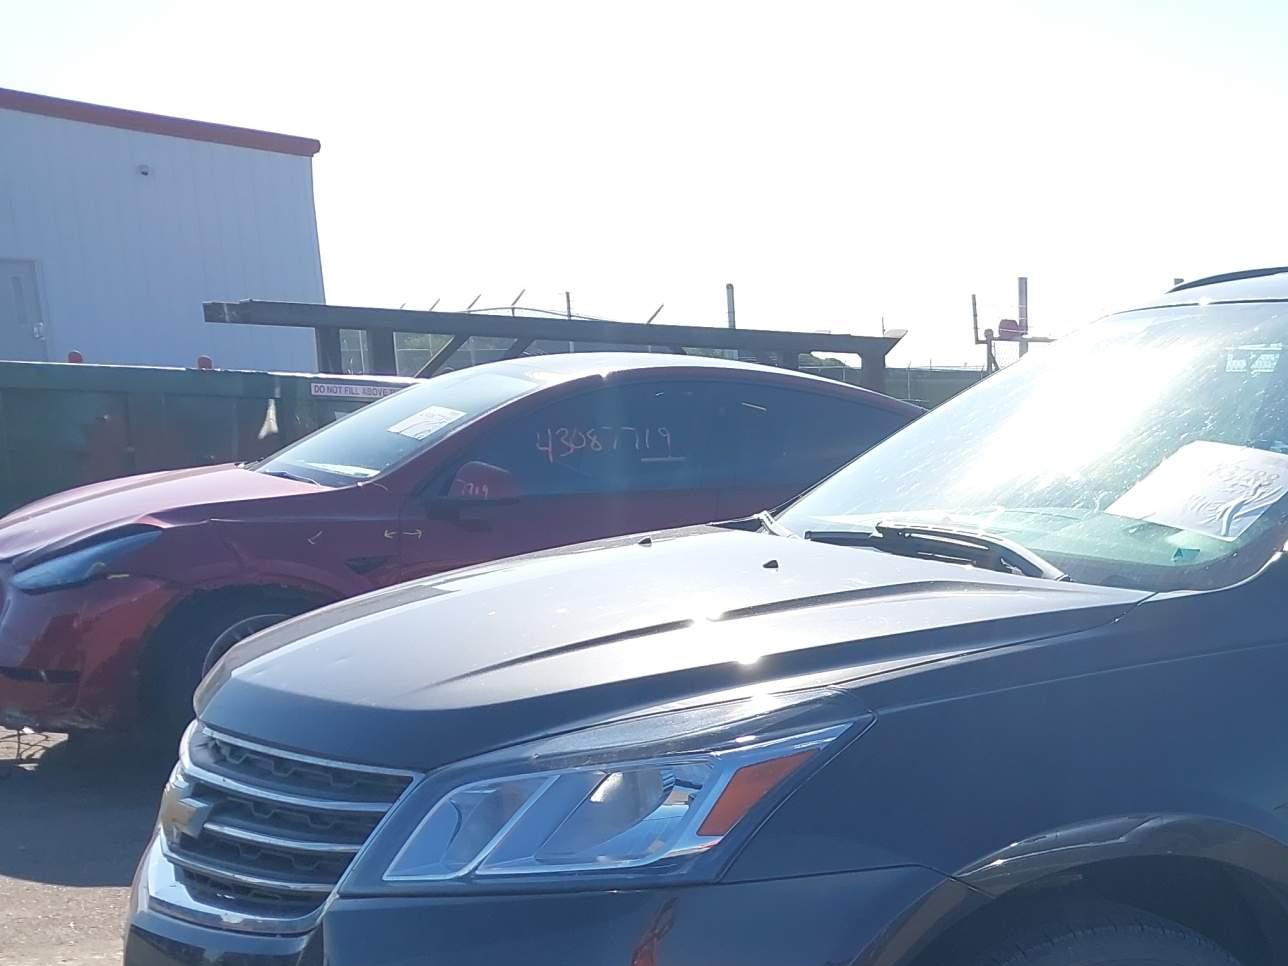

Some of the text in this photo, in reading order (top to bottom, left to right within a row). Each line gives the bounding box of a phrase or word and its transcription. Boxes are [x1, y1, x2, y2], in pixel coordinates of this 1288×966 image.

[314, 384, 326, 393] DO
[327, 385, 342, 394] NOT
[344, 386, 361, 395] FILL
